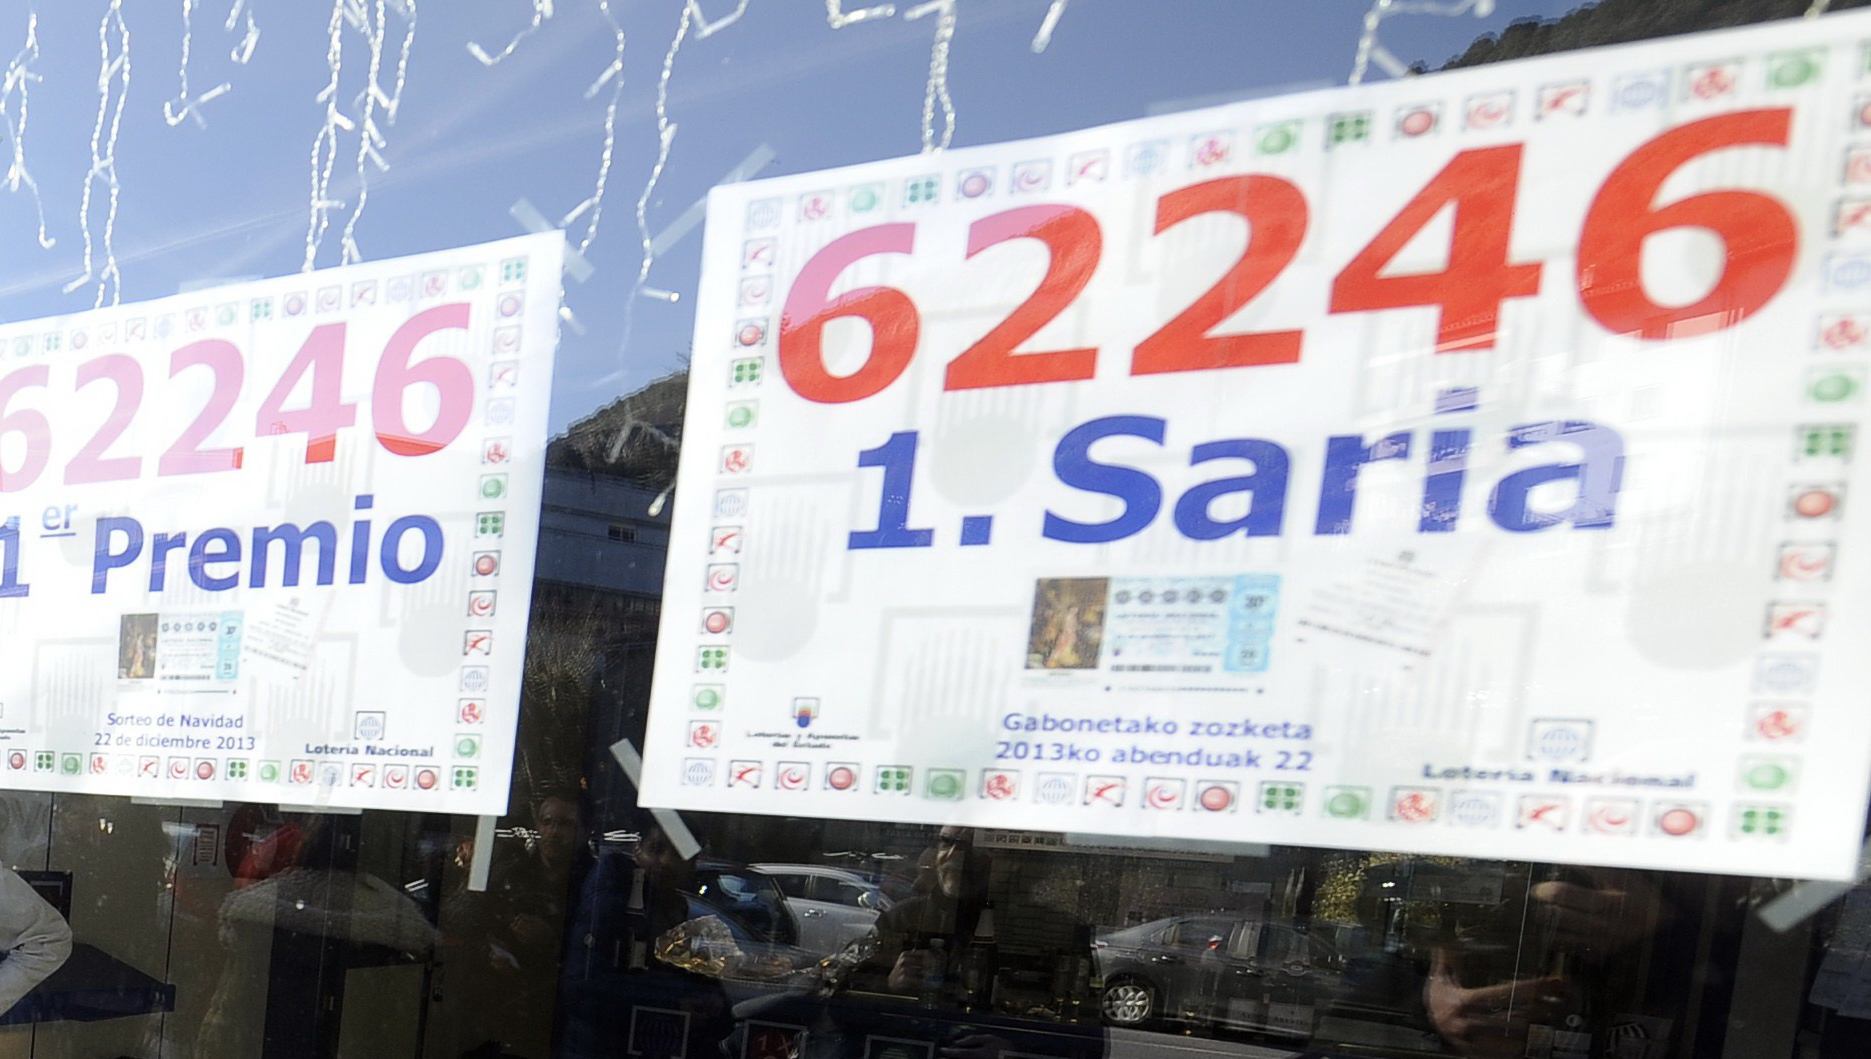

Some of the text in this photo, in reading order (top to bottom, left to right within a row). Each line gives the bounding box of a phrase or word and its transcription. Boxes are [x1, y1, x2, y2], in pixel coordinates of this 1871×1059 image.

[777, 106, 1801, 406] 62246
[846, 382, 1629, 550] 1. Saria
[90, 493, 444, 594] Premio
[107, 712, 244, 728] Sorteo de Navidad
[1002, 711, 1314, 740] Gabonetako zozketa
[94, 732, 256, 750] 22 de diciembre 2013
[365, 744, 434, 757] Nacional
[995, 740, 1314, 771] 2013ko abenduak 22
[1549, 767, 1696, 788] Nacional
